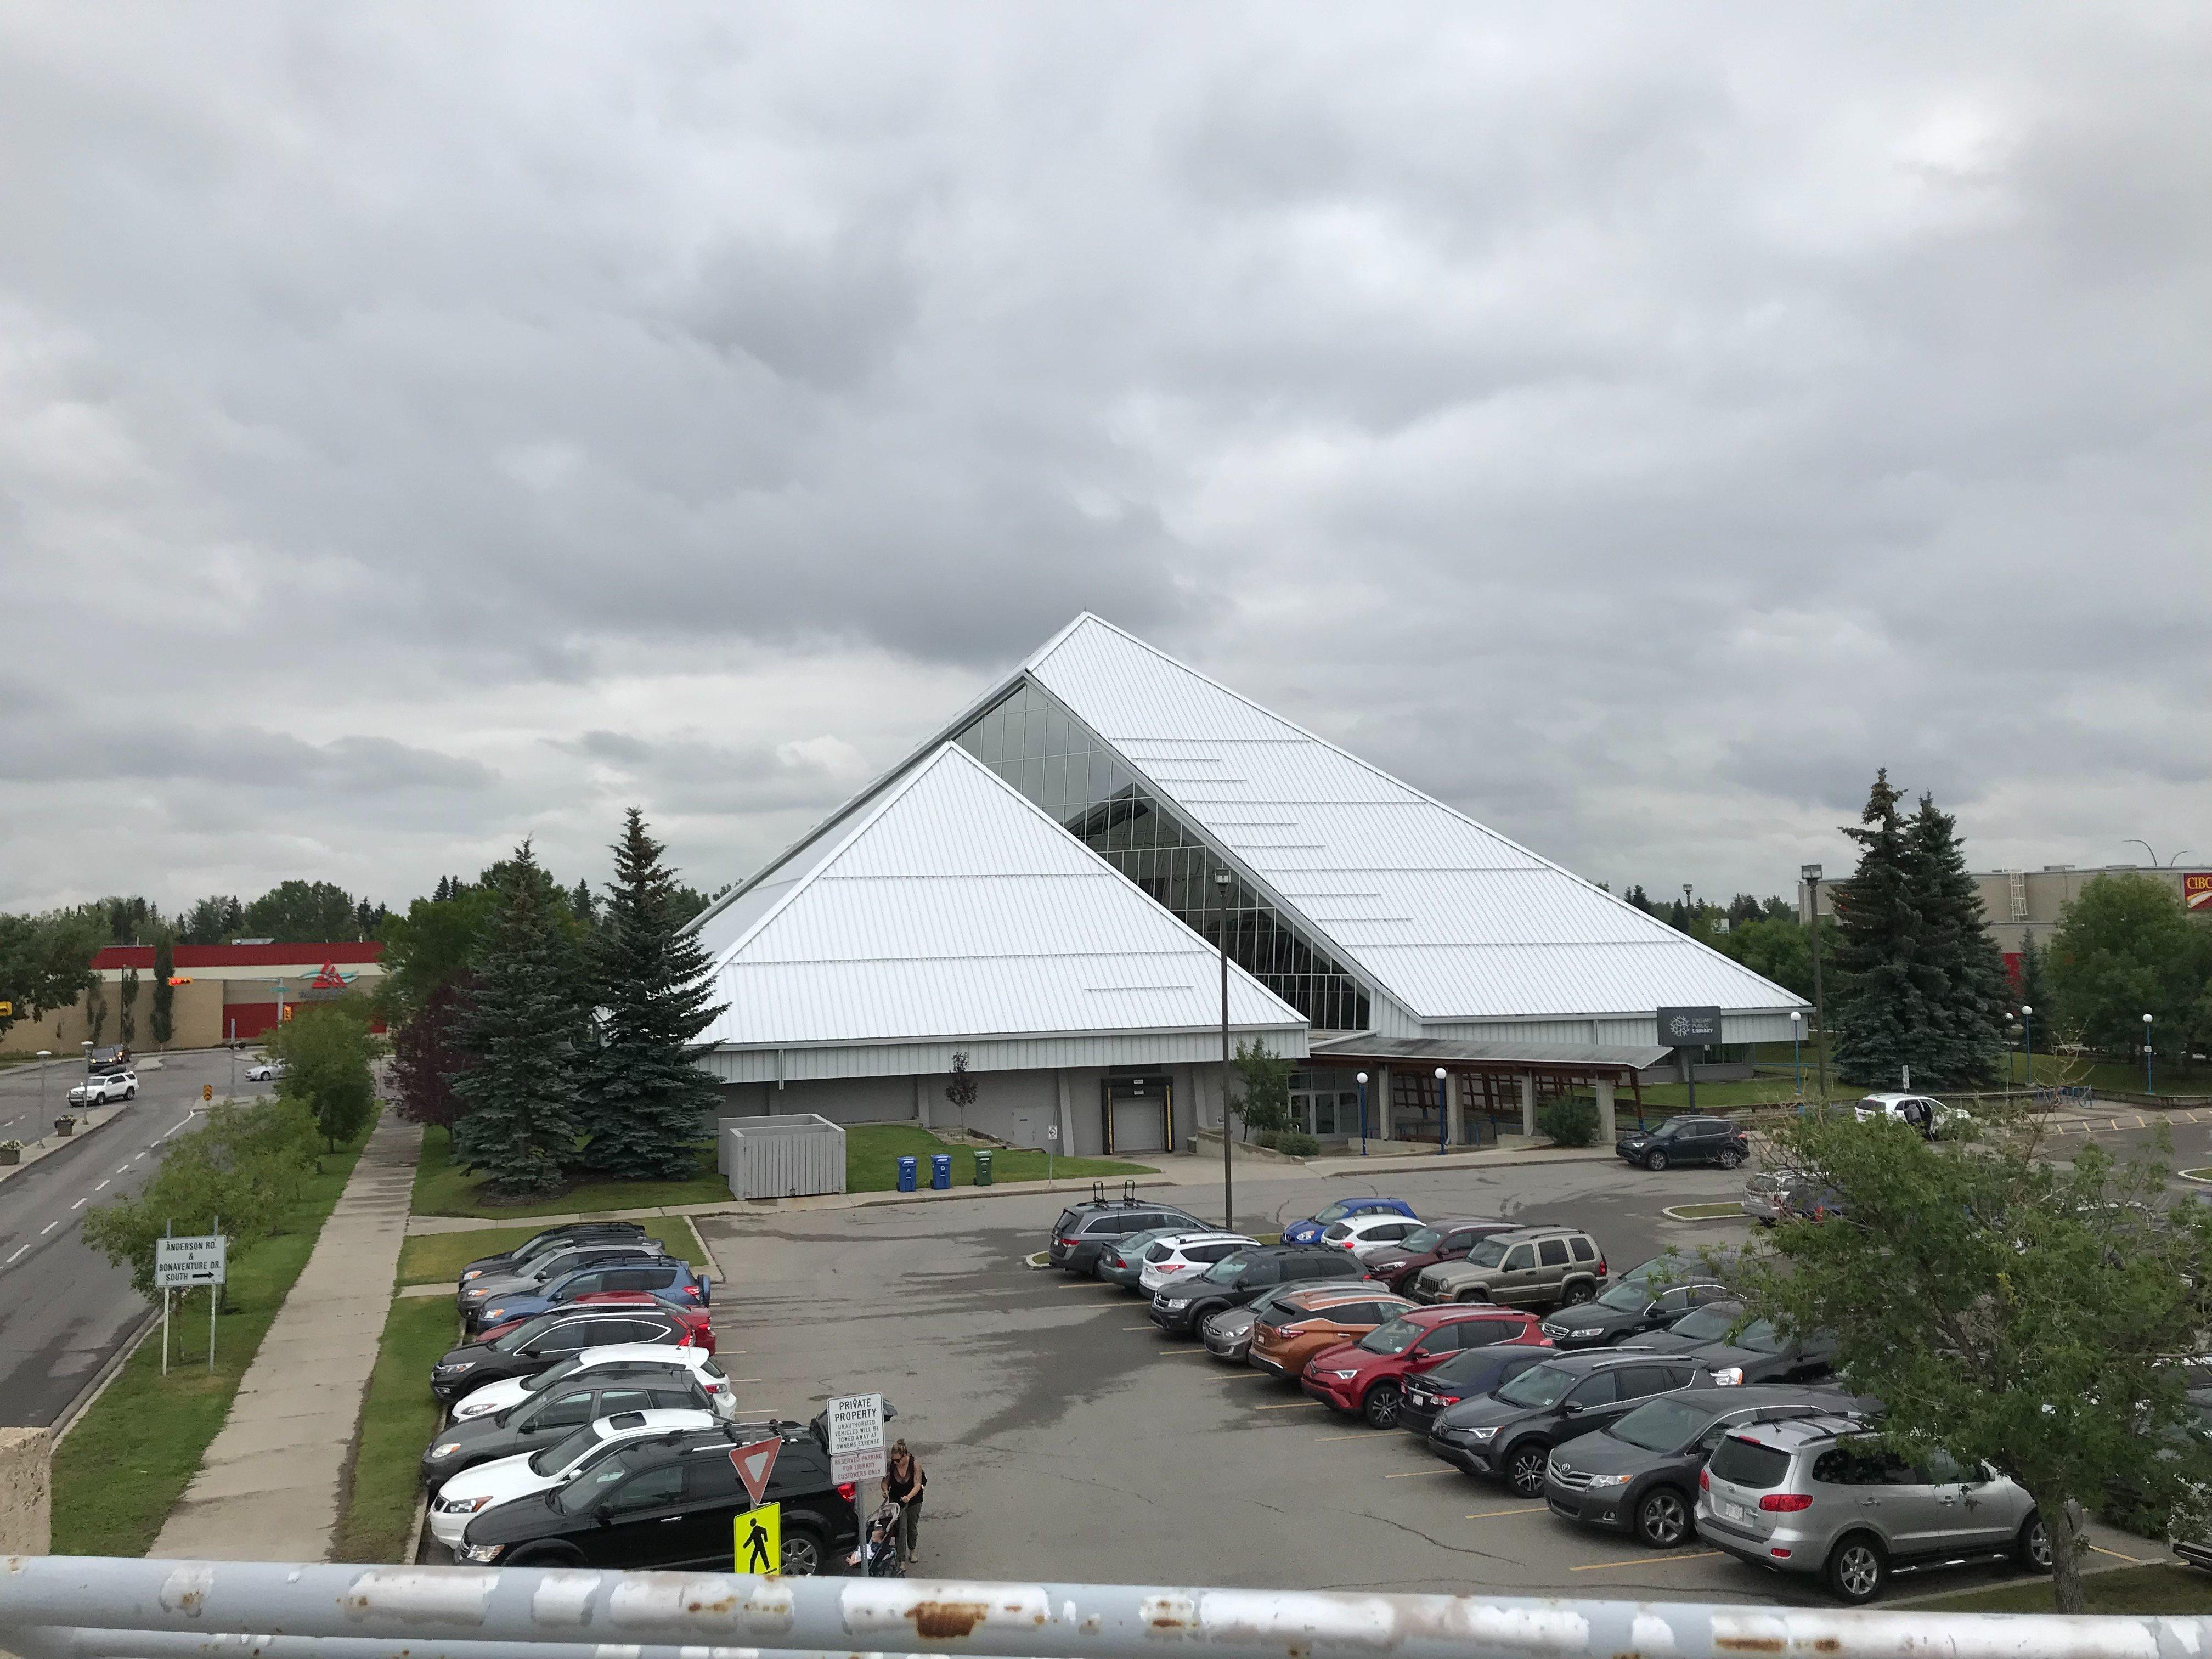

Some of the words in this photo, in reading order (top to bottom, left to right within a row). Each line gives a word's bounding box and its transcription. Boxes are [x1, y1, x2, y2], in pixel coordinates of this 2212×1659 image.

[2187, 877, 2212, 889] CIBC
[166, 1242, 203, 1251] ANDERSON
[159, 1262, 207, 1272] BONAVENTURE
[166, 1273, 188, 1281] SOUTH
[839, 1398, 871, 1410] PRIVATE
[835, 1408, 877, 1422] PROPERTY
[838, 1419, 876, 1430] UNAUTHORIZED
[835, 1429, 859, 1437] VEHICLES
[858, 1438, 879, 1447] EXPENSE
[834, 1456, 860, 1465] RESERVED
[838, 1471, 866, 1480] CUSTOMERS
